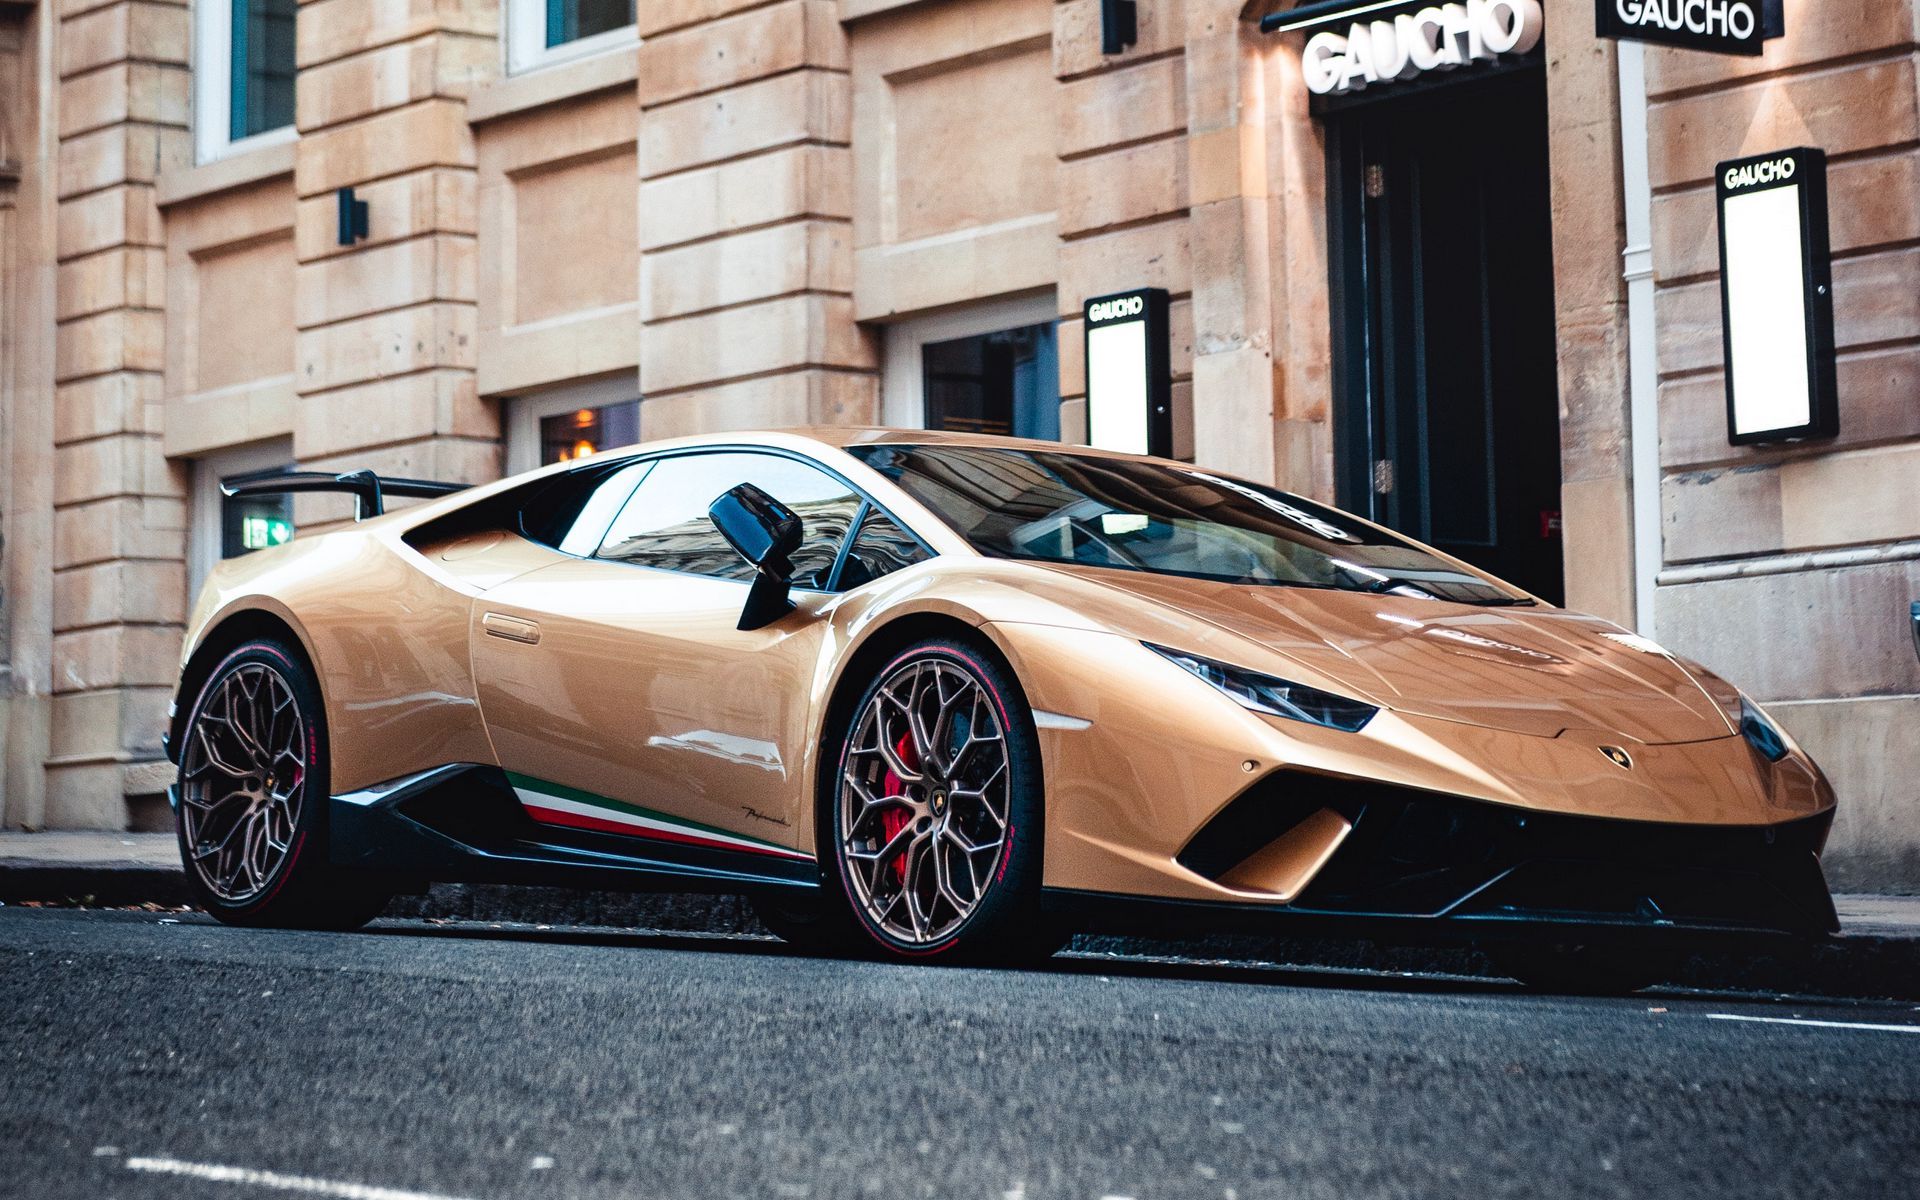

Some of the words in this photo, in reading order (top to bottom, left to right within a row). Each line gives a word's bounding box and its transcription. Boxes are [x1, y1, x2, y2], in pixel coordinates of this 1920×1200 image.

[1616, 0, 1755, 40] GAUCHO
[1302, 0, 1527, 94] GAUCHO
[1724, 157, 1795, 189] GAUCHO
[1089, 296, 1143, 322] GAUCHO
